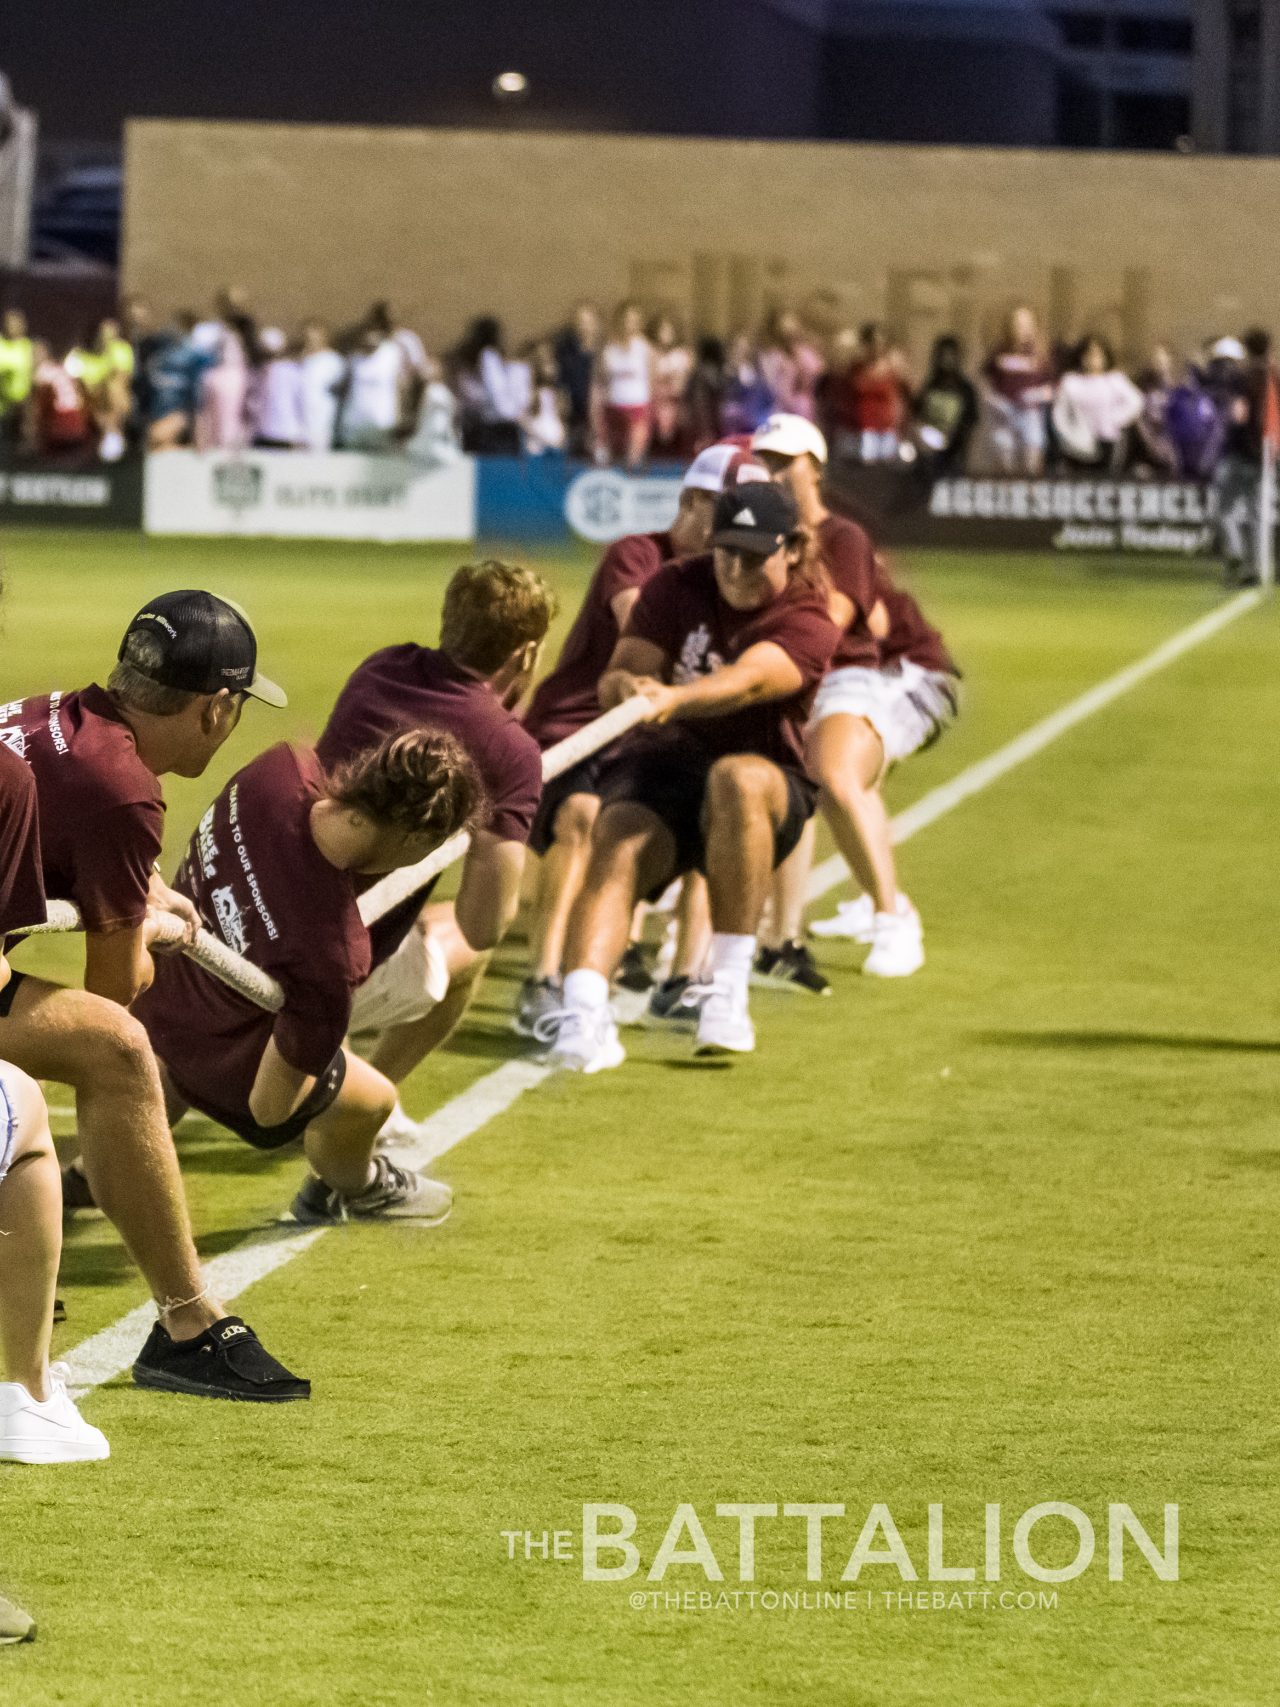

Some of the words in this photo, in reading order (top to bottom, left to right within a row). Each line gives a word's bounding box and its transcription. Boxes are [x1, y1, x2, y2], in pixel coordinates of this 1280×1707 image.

[231, 824, 243, 843] TO
[237, 845, 252, 873] OUR
[246, 872, 280, 940] SPONSORS!
